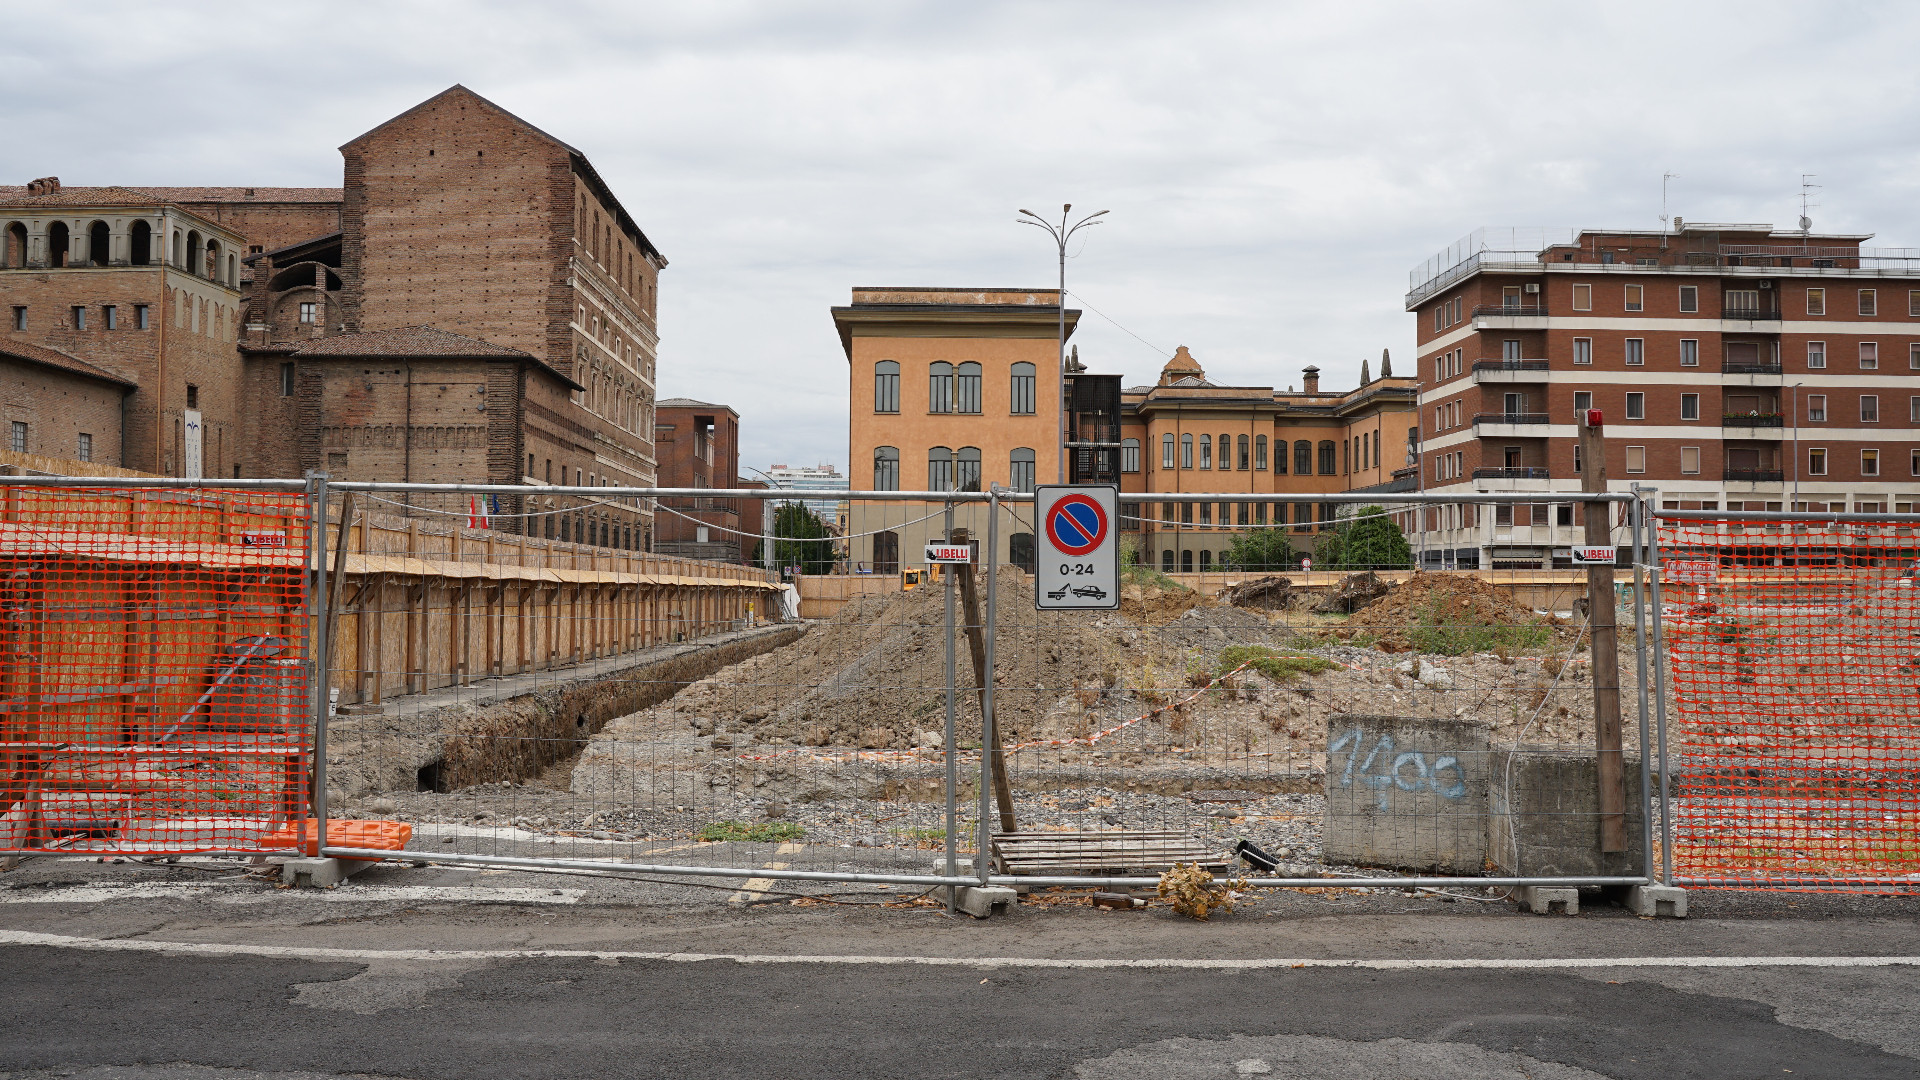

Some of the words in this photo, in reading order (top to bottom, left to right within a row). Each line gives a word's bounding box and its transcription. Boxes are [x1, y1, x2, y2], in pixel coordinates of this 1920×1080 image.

[936, 548, 968, 559] LIBELLI
[1583, 549, 1614, 559] LIBELLI
[1059, 563, 1095, 575] 0-24
[1328, 727, 1466, 813] 1400
